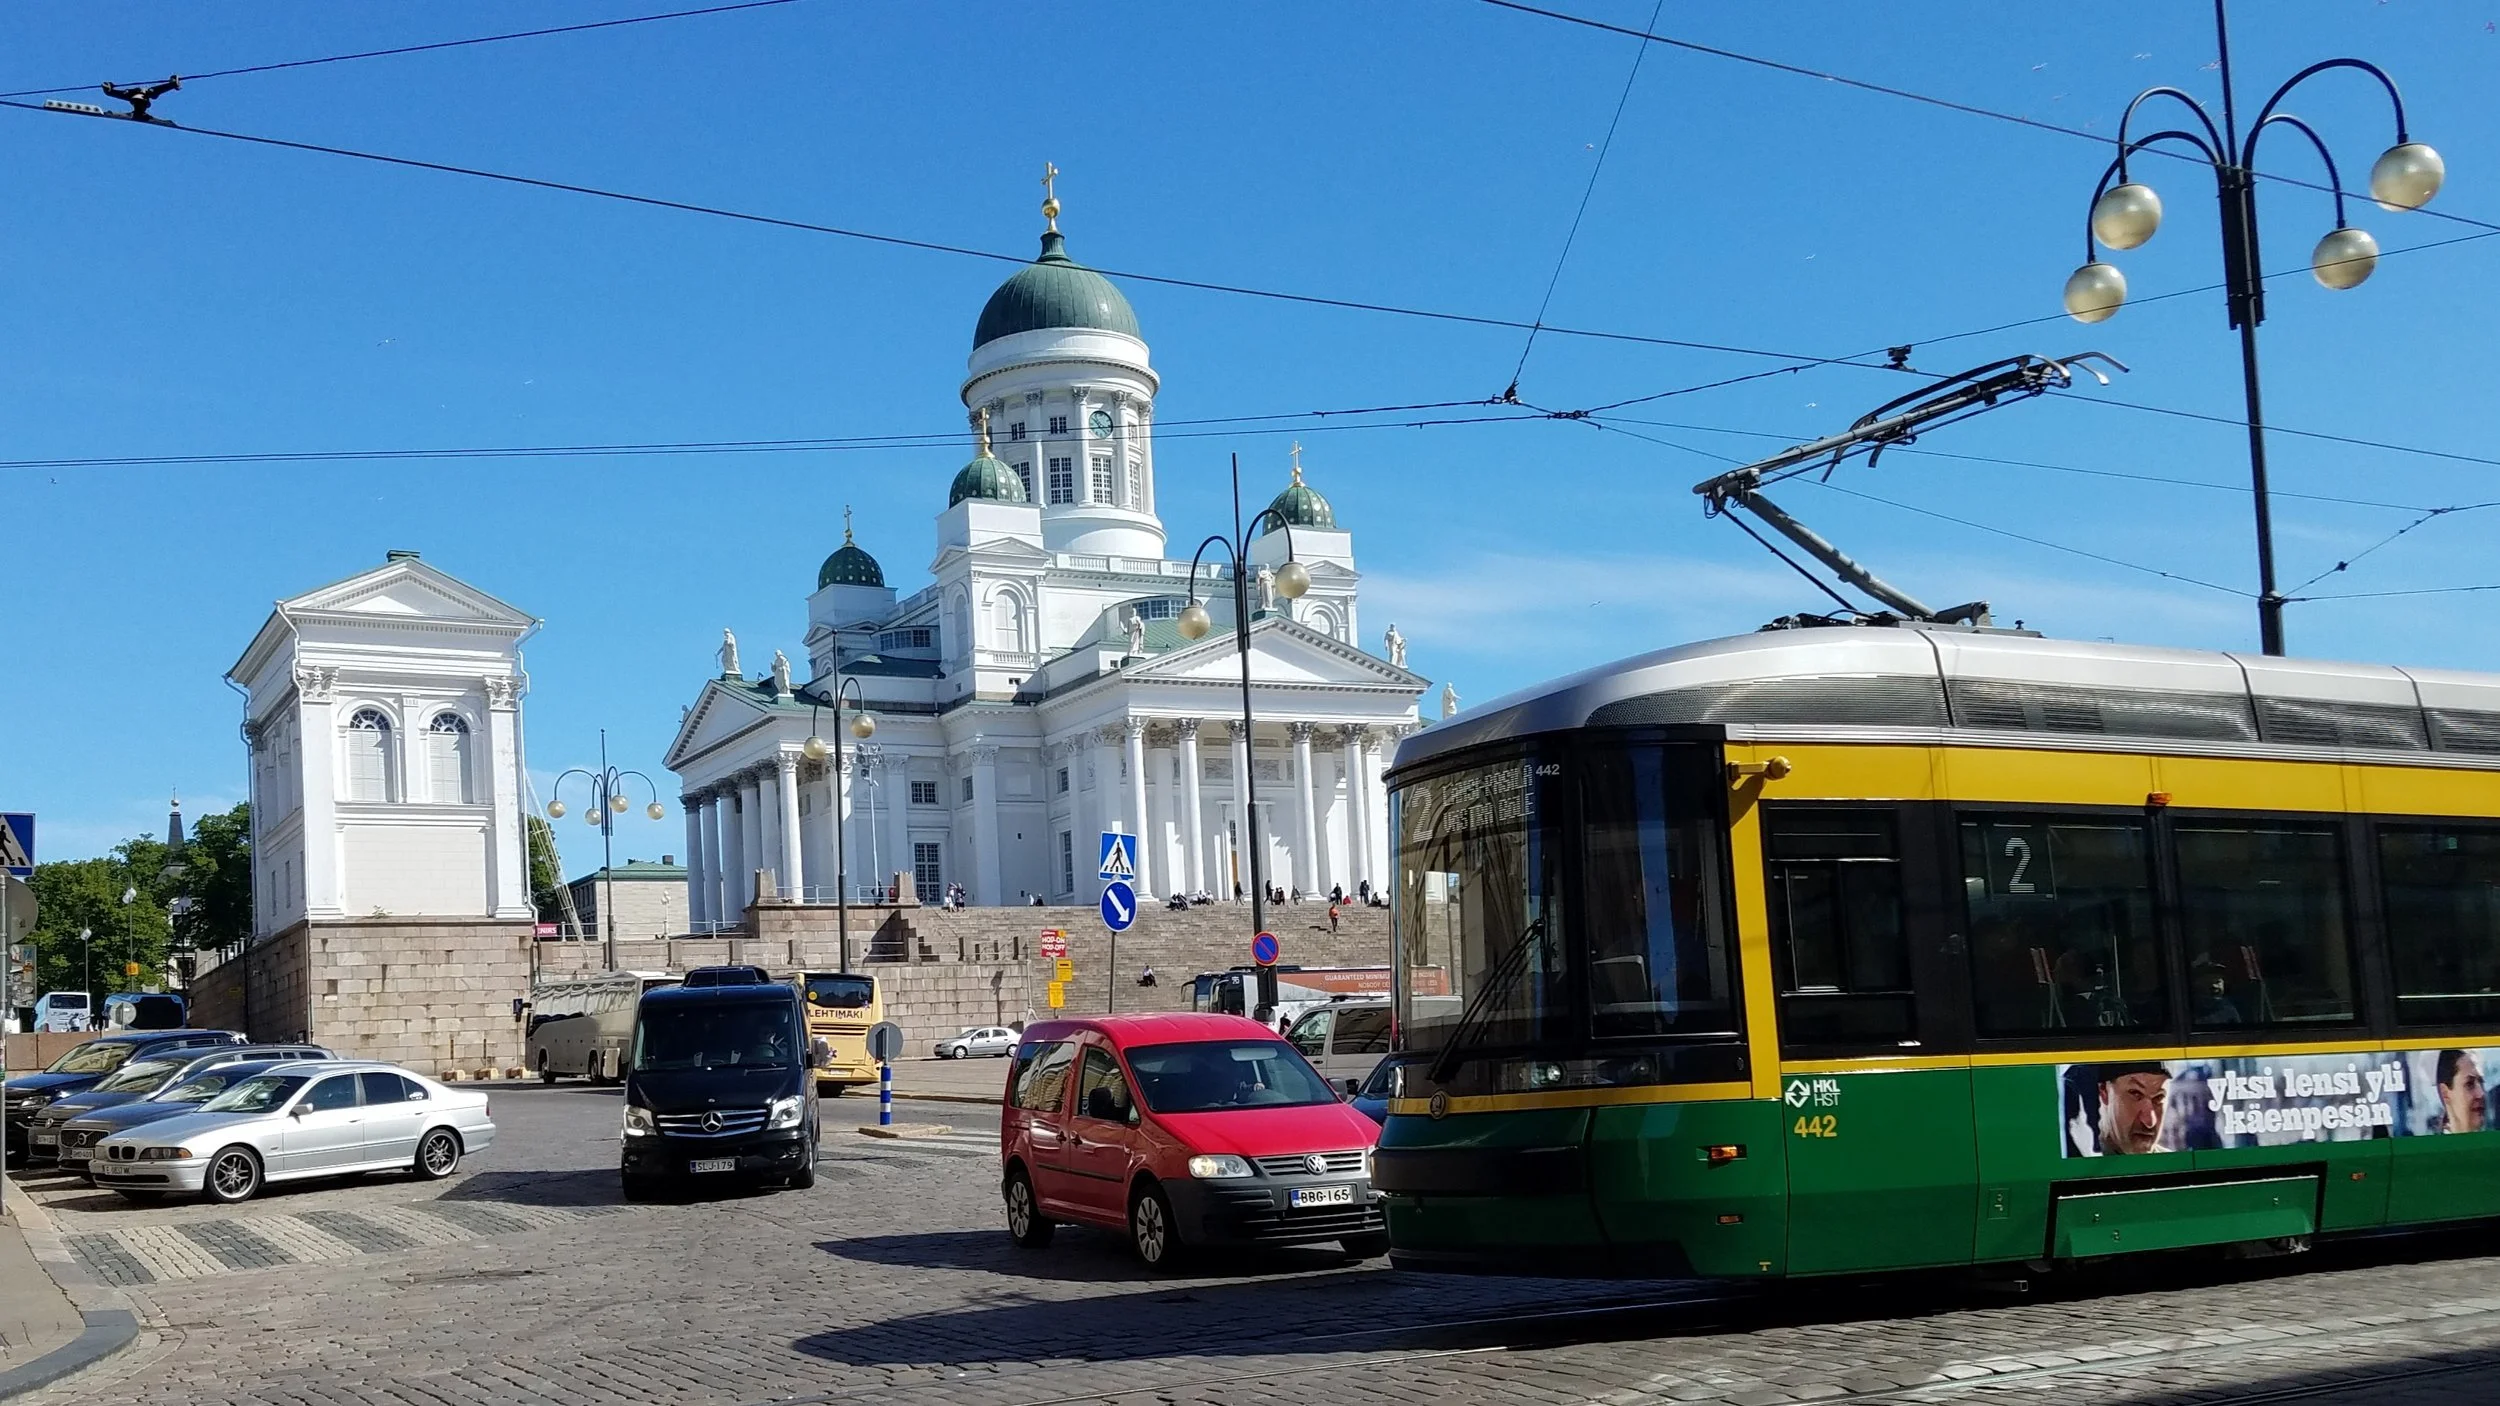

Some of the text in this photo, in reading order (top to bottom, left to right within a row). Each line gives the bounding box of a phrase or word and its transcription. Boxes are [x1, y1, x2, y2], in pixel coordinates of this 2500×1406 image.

[1535, 764, 1560, 777] 442
[1411, 786, 1434, 843] 2
[2004, 837, 2036, 893] 2
[1813, 1079, 1841, 1093] HKL
[2206, 1060, 2406, 1112] yksi lensi yli
[1814, 1092, 1842, 1107] HST
[1794, 1114, 1838, 1138] 442
[2223, 1098, 2394, 1140] käenpesän
[697, 1161, 734, 1171] SLJ-179
[1300, 1189, 1350, 1204] BBG-165
